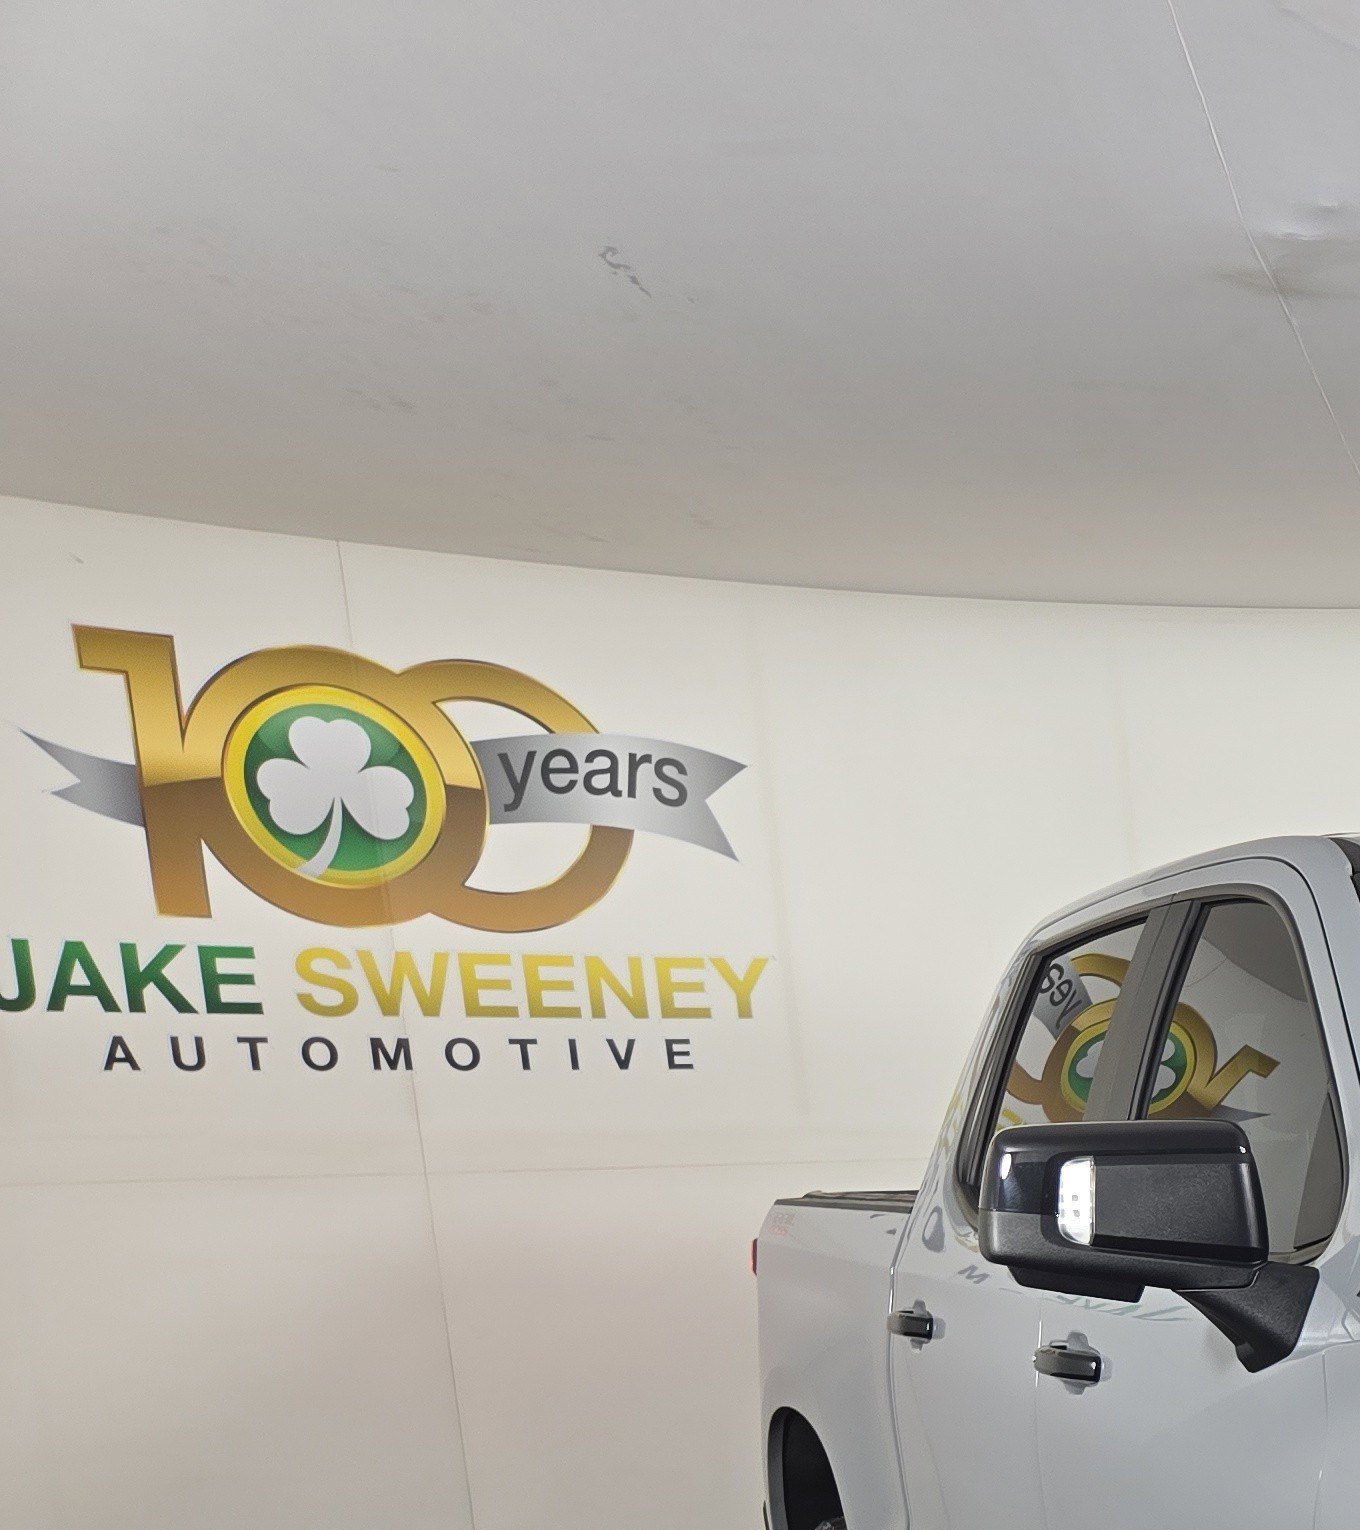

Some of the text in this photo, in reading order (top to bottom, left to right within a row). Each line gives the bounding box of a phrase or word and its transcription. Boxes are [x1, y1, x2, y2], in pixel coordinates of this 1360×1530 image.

[497, 747, 689, 812] years
[0, 938, 768, 1020] JAKE SWEENEY
[103, 1036, 695, 1072] AUTOMOTIVE
